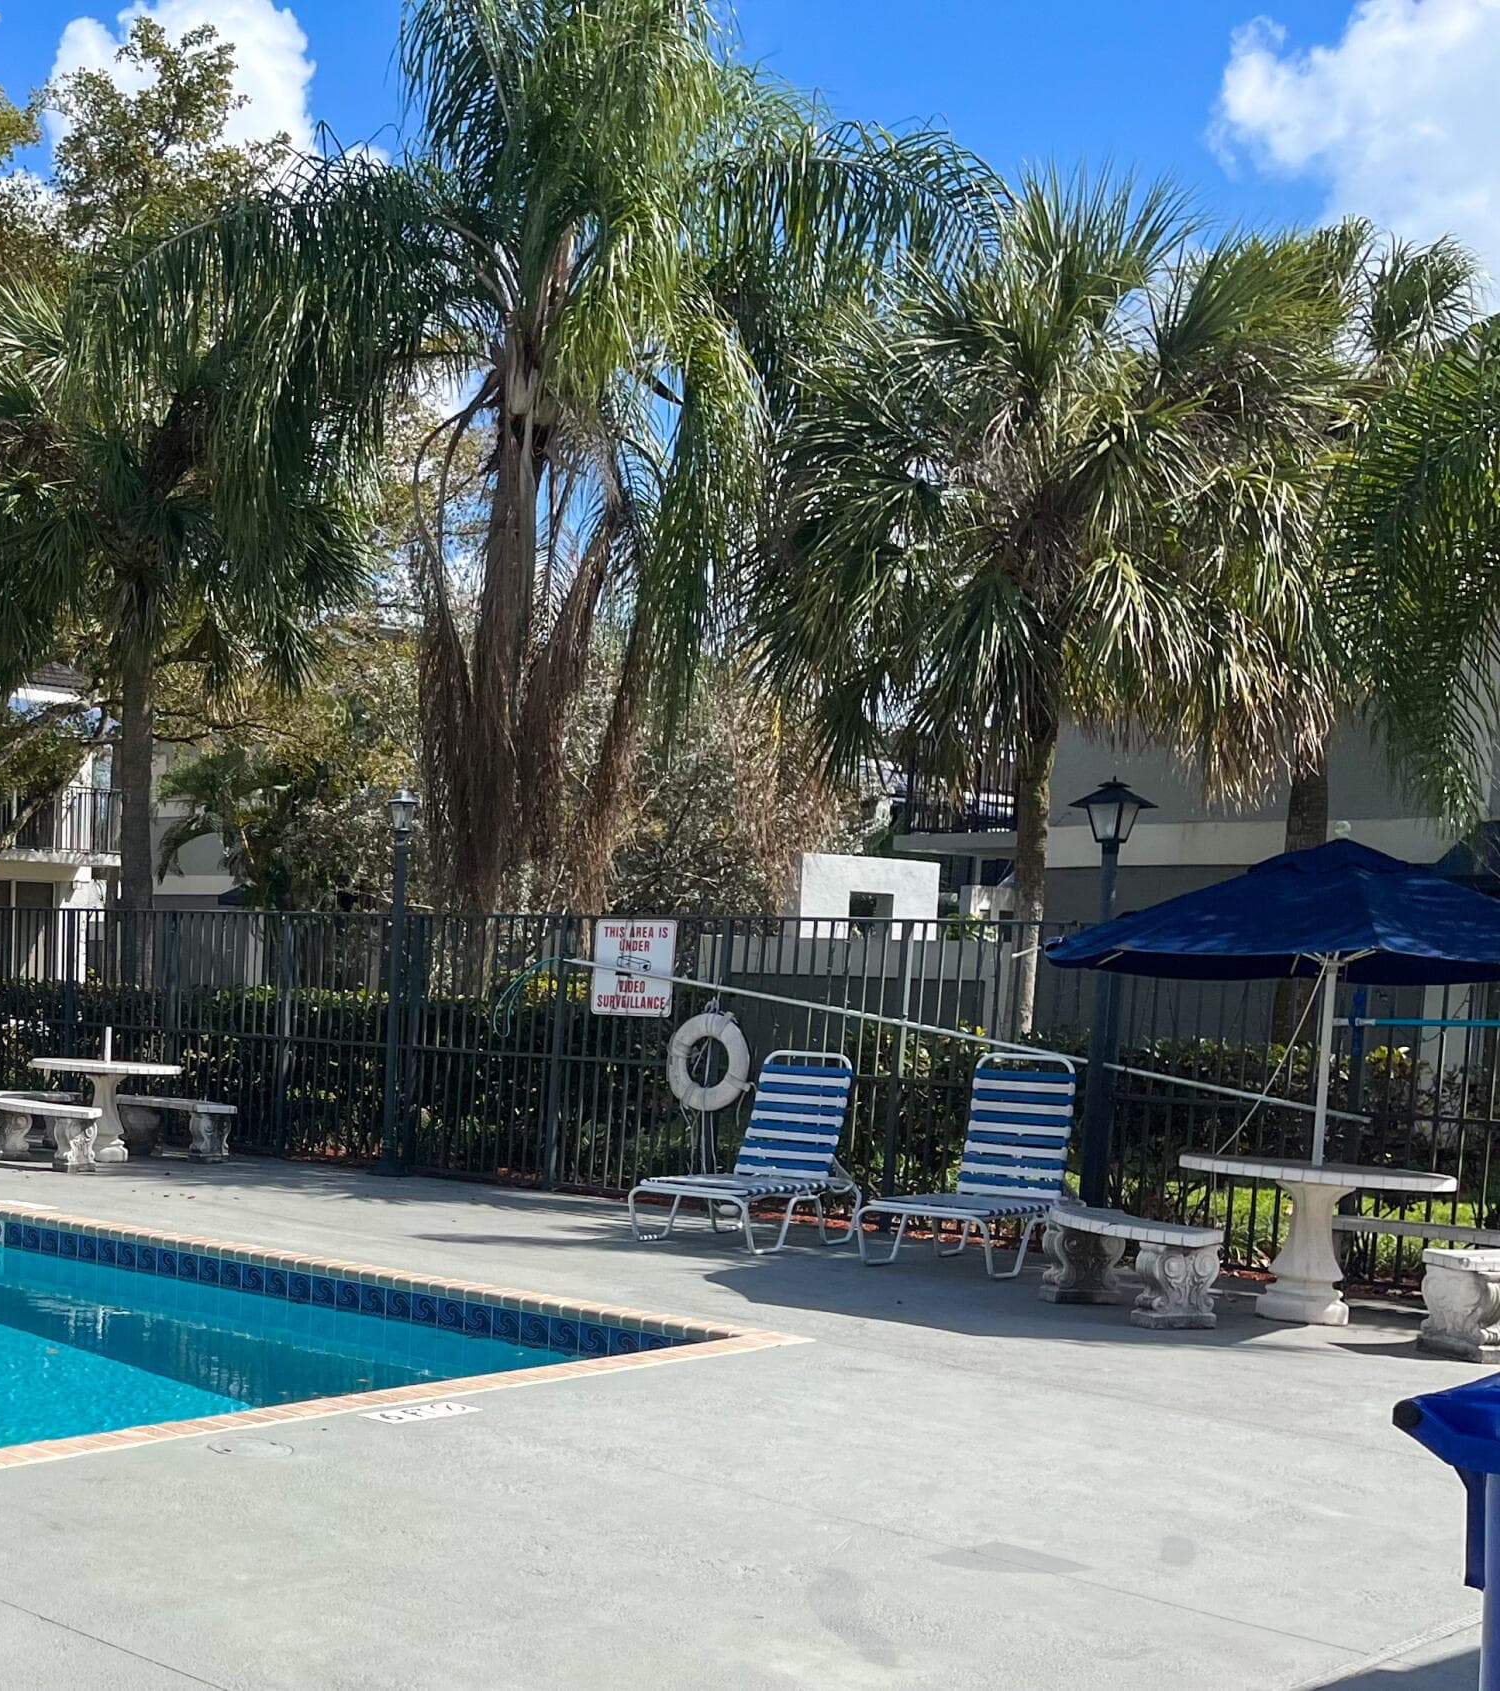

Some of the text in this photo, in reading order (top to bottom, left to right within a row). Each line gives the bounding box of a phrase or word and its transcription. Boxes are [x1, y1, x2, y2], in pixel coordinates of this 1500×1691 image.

[604, 926, 669, 939] THIS AREA IS
[619, 940, 650, 952] UNDER
[618, 980, 646, 994] VIDEO
[597, 994, 666, 1010] SURVEILLANCE
